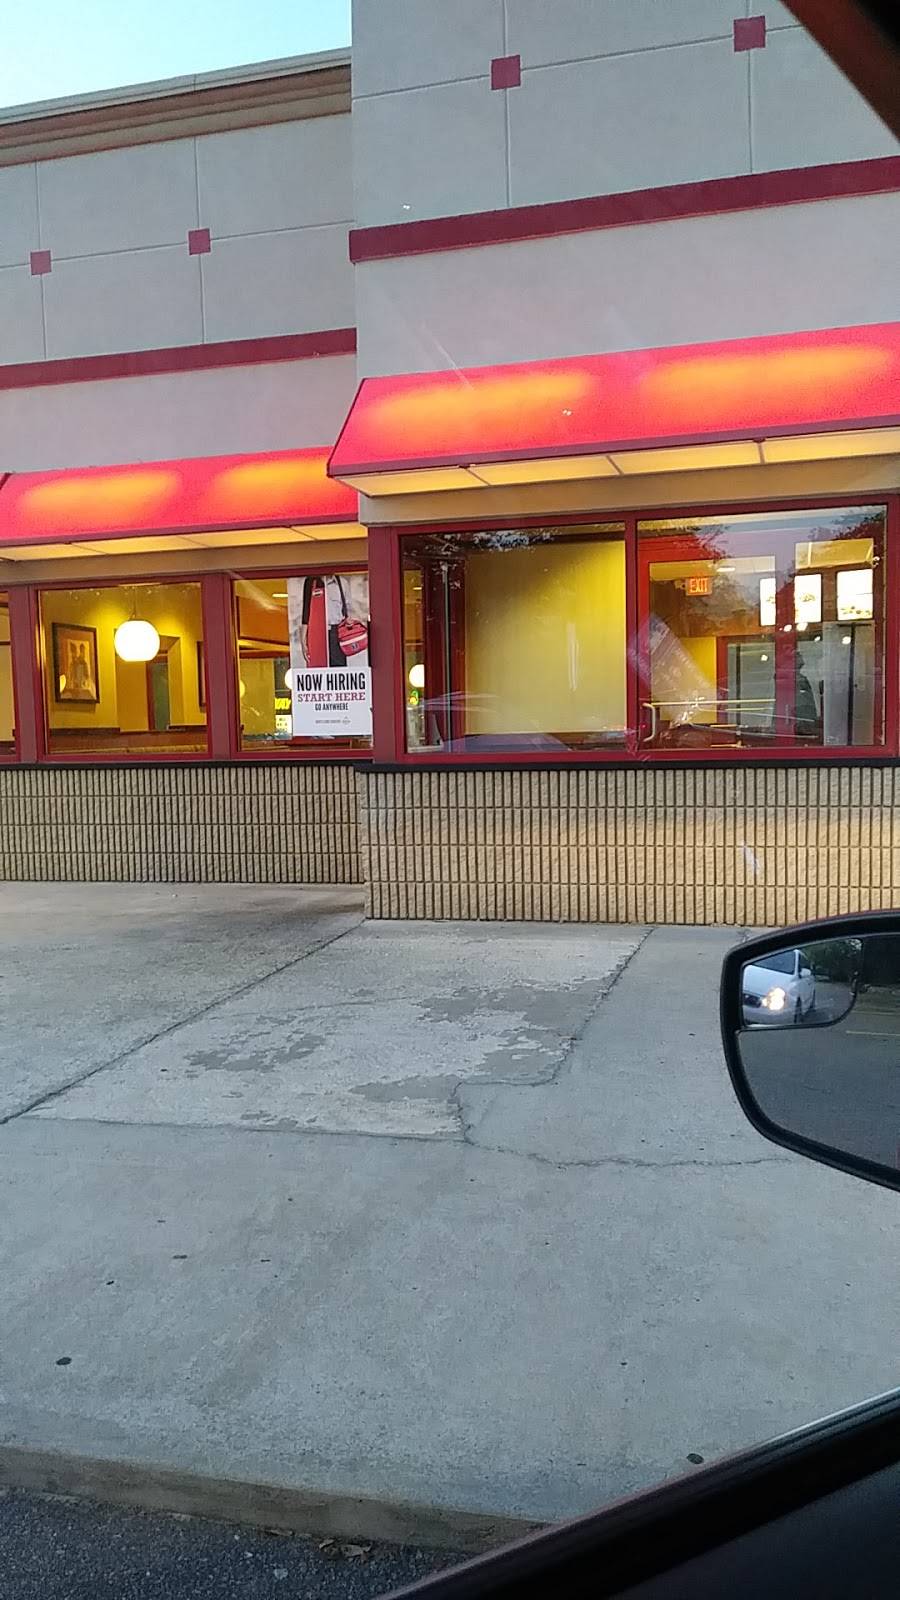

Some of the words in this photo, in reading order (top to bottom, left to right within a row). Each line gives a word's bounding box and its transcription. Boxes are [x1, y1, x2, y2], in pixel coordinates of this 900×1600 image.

[690, 578, 707, 592] EXIT
[297, 674, 322, 691] NOW
[326, 672, 366, 691] HIRING
[297, 693, 333, 702] START
[335, 692, 366, 701] HERE
[315, 703, 322, 711] GO
